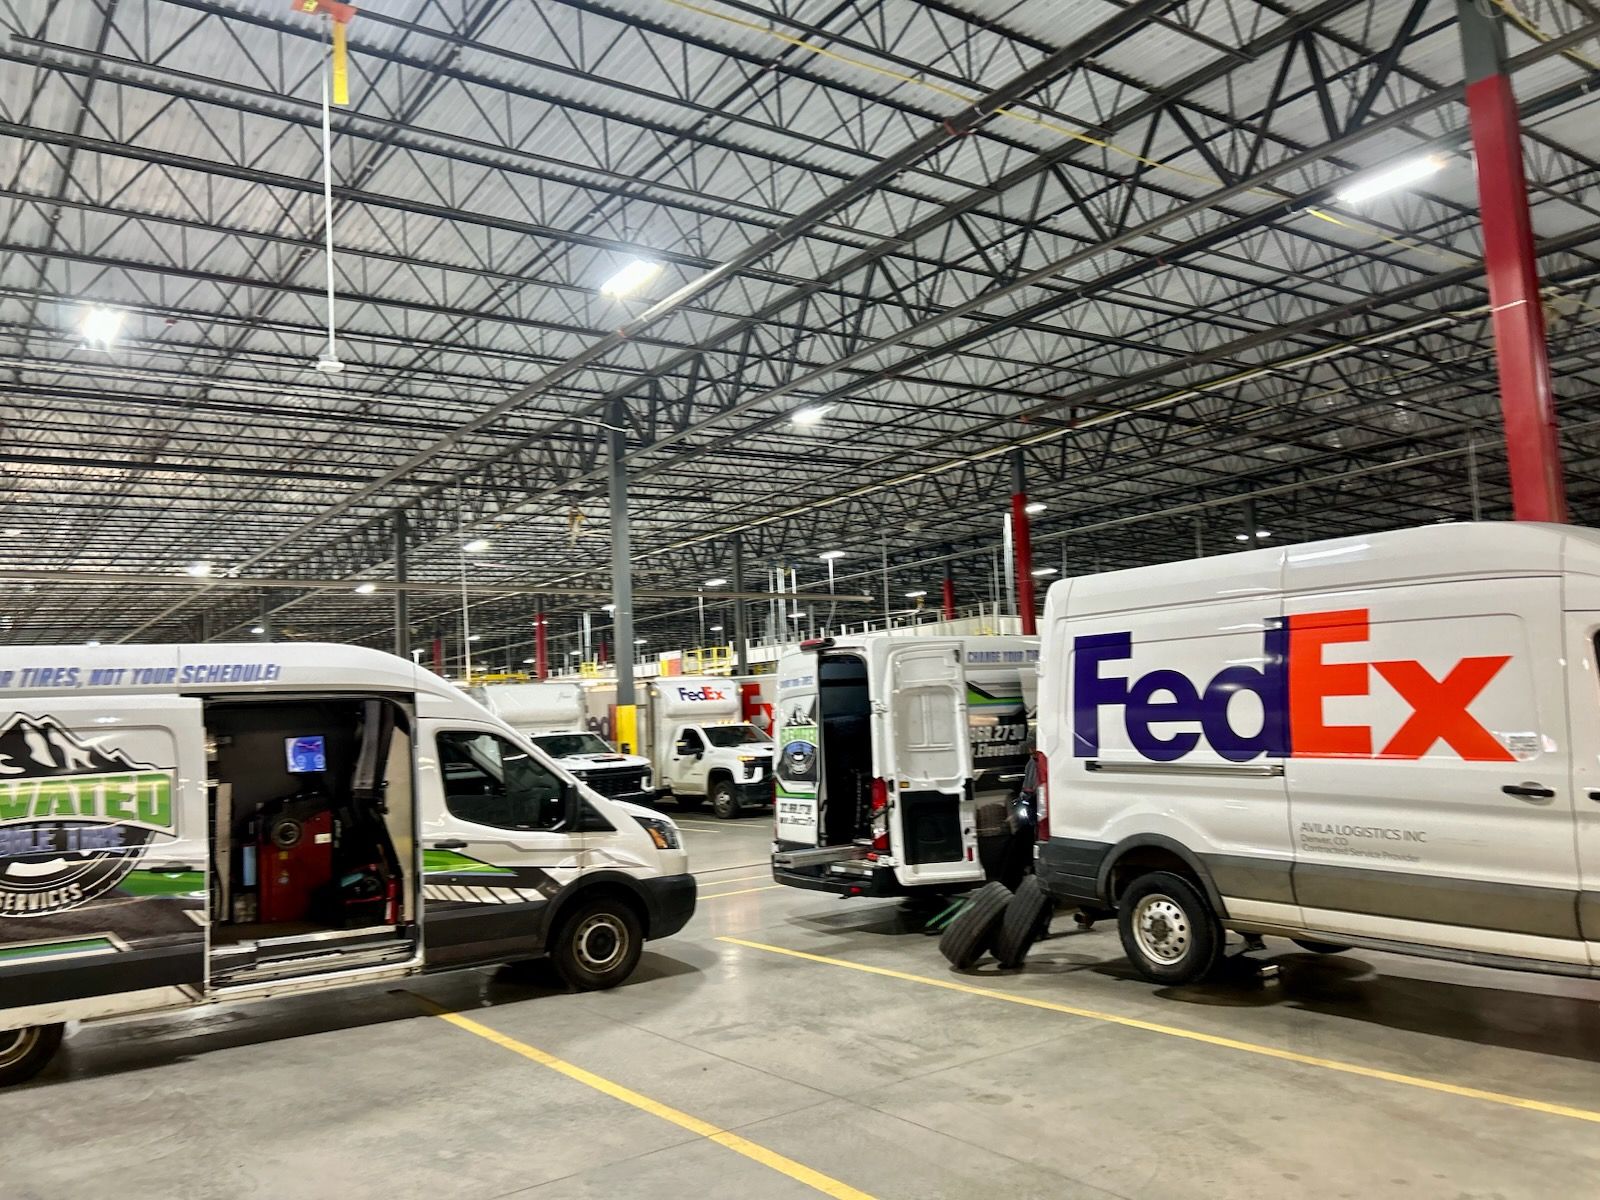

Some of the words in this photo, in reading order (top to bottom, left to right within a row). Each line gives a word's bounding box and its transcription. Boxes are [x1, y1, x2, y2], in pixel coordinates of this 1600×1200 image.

[19, 667, 82, 688] TIRES,
[88, 668, 127, 686] NOT
[130, 667, 177, 685] YOUR
[179, 663, 281, 684] SCHEDULE!
[1074, 608, 1518, 762] FedEx
[677, 686, 726, 701] FedEx
[1300, 822, 1335, 835] AVILA
[1336, 824, 1401, 842] LOGISTICS
[1402, 830, 1428, 843] INC
